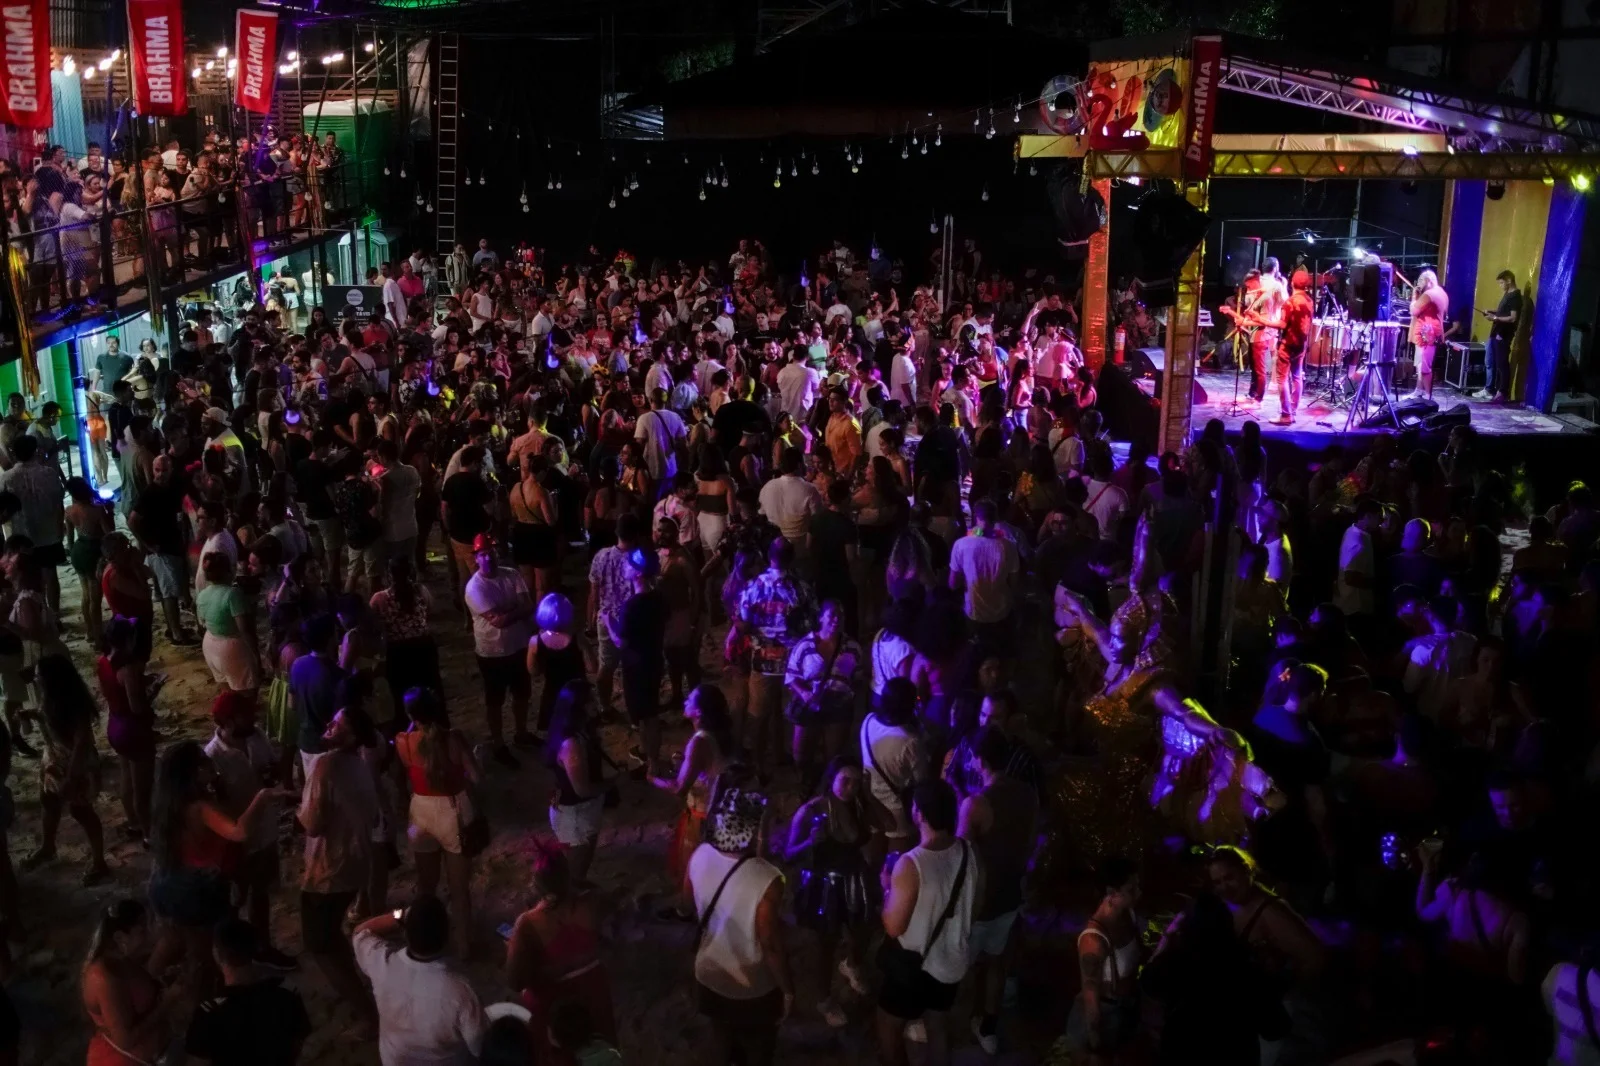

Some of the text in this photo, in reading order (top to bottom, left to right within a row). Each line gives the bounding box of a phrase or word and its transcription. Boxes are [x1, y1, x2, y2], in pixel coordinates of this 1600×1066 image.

[2, 4, 38, 112] BRAHMA
[145, 15, 173, 104] BRAHMA
[243, 26, 266, 99] BRAHMA
